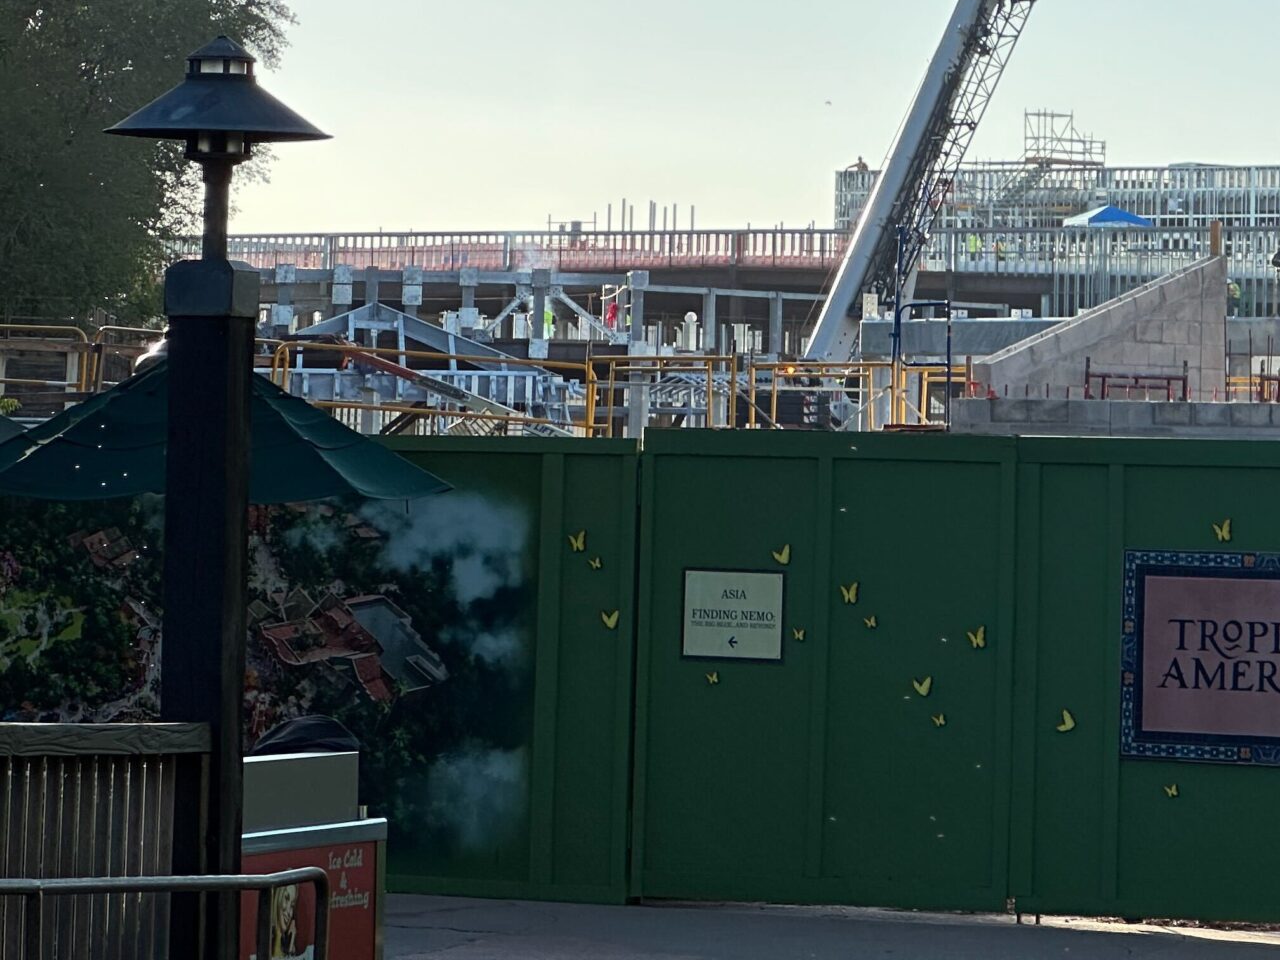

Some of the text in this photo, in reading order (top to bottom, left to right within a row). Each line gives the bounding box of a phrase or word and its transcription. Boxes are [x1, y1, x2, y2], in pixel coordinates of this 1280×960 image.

[721, 589, 747, 600] ASIA
[692, 608, 738, 620] FINDING
[329, 849, 363, 870] Ice Cold
[340, 872, 347, 889] &
